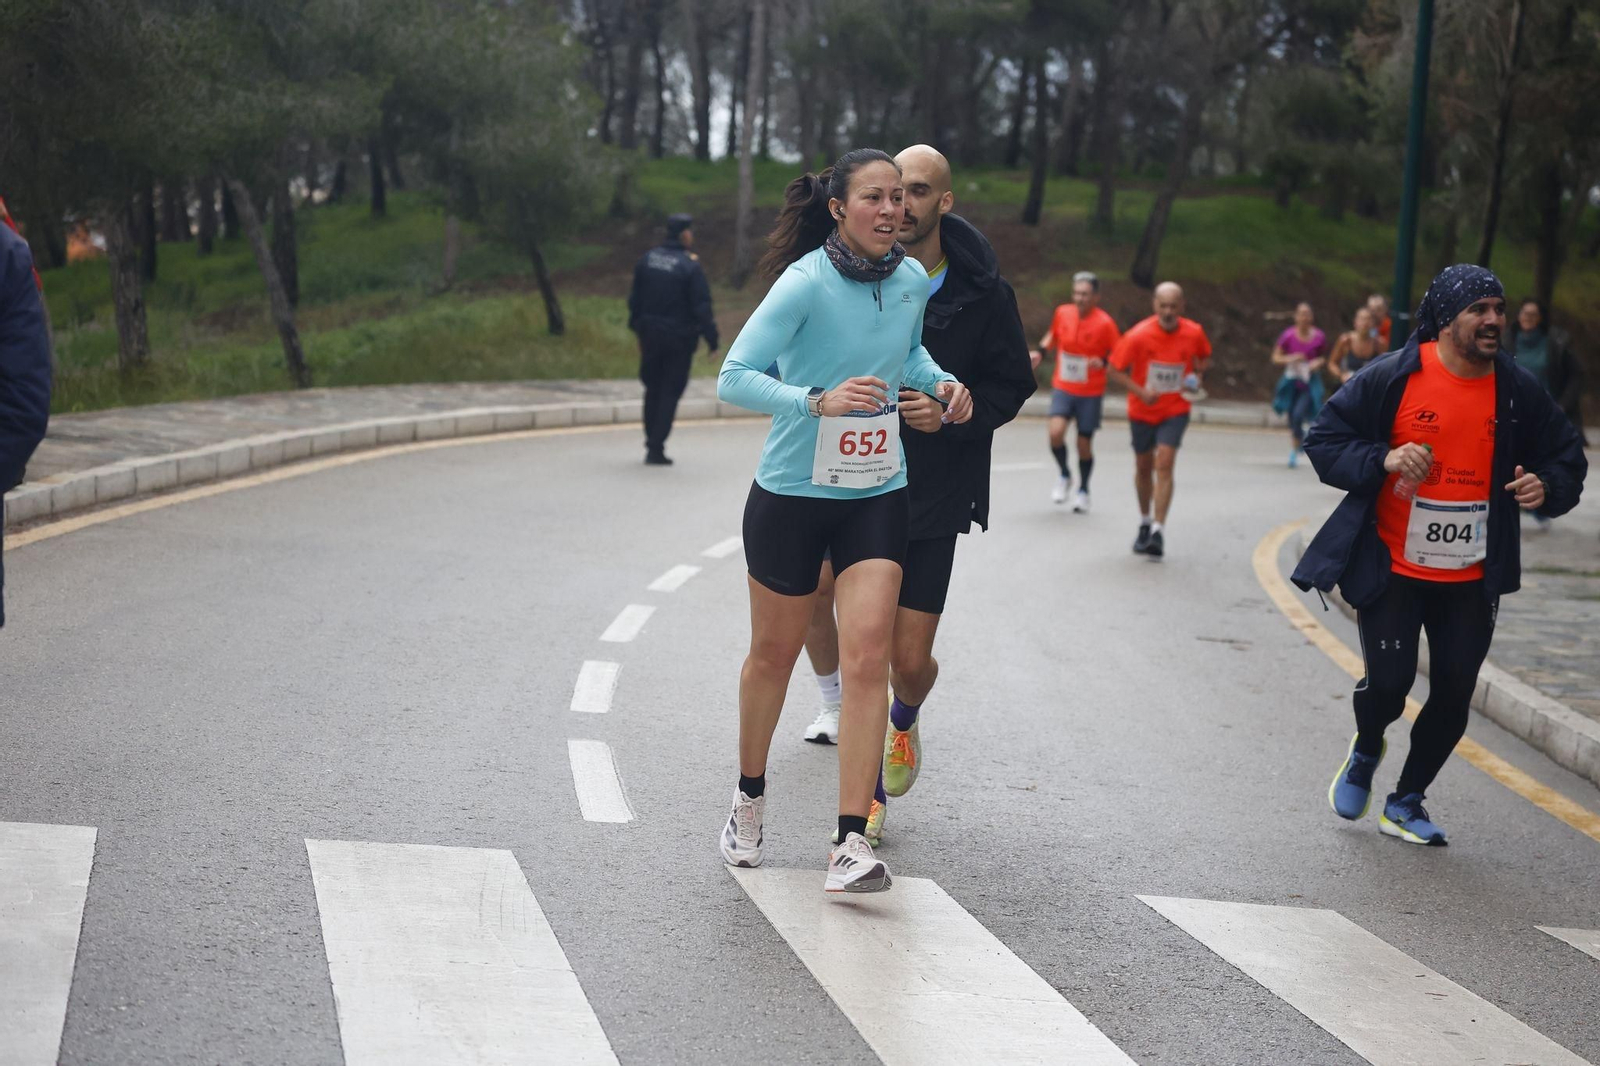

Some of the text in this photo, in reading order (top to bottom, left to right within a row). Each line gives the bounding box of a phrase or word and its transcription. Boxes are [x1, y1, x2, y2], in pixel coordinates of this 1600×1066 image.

[839, 429, 887, 457] 652
[1446, 467, 1476, 477] Ciudad
[1458, 478, 1485, 487] Málaga
[1426, 522, 1473, 544] 804
